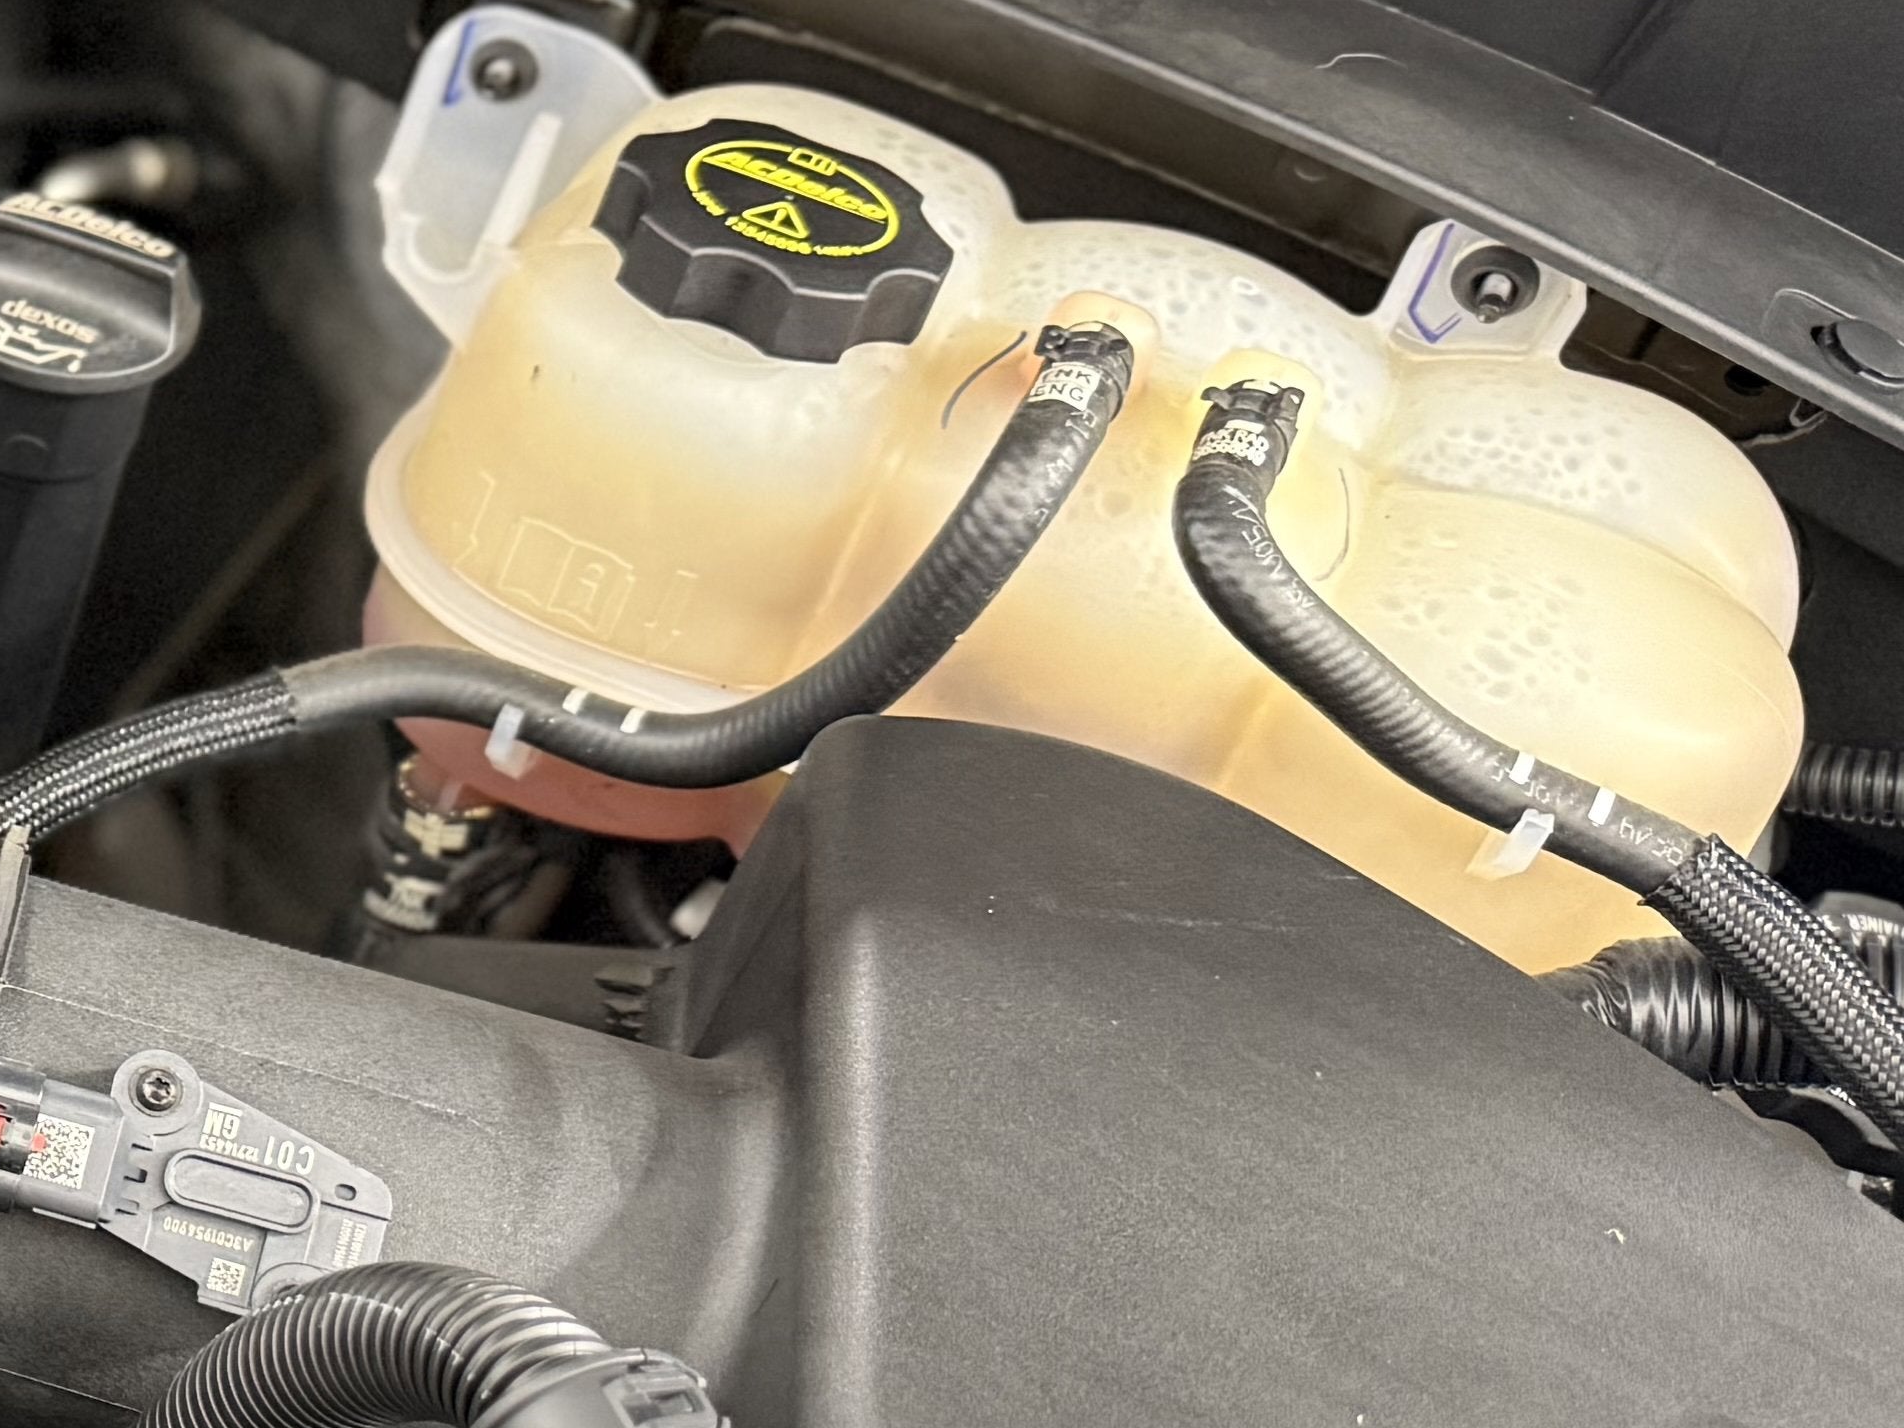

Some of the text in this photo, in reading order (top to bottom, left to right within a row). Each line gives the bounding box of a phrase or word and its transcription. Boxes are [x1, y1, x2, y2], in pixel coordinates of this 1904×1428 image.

[703, 152, 887, 220] ACDelco
[0, 299, 101, 344] dexos
[1032, 383, 1084, 402] ENG
[202, 1109, 240, 1138] GM
[264, 1135, 314, 1175] C01
